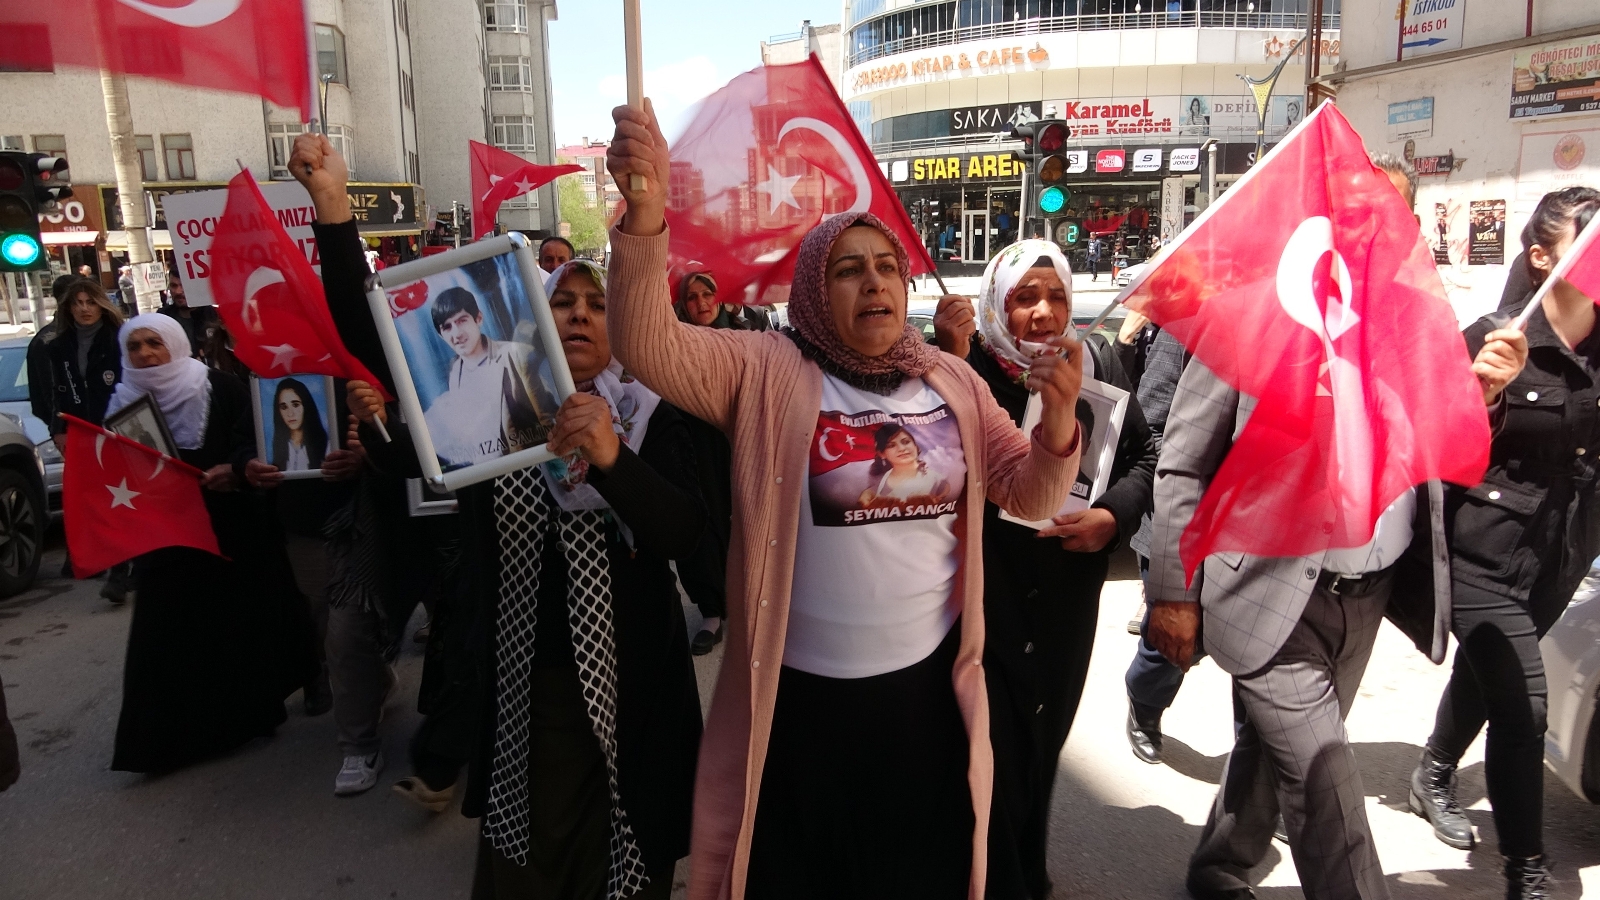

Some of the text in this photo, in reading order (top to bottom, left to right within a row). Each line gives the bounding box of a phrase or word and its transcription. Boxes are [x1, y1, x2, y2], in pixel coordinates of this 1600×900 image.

[1402, 17, 1447, 36] 444 65 01
[911, 55, 952, 76] KİTAP
[957, 53, 970, 69] &
[977, 46, 1024, 67] CAFE
[1511, 92, 1555, 105] SARAY MARKET
[953, 107, 1003, 129] SAKA
[1069, 118, 1172, 137] yan Kuaförü
[914, 153, 1026, 181] STAR AREN
[1554, 173, 1584, 181] WAFFLE
[347, 193, 379, 208] NİZ
[176, 206, 318, 245] ÇOCUKLARMIZI
[1067, 226, 1078, 243] 2
[1476, 232, 1497, 241] VAN
[183, 237, 321, 279] İSTİYORZ
[148, 272, 164, 280] BOYUT
[844, 506, 902, 524] ŞEYMA
